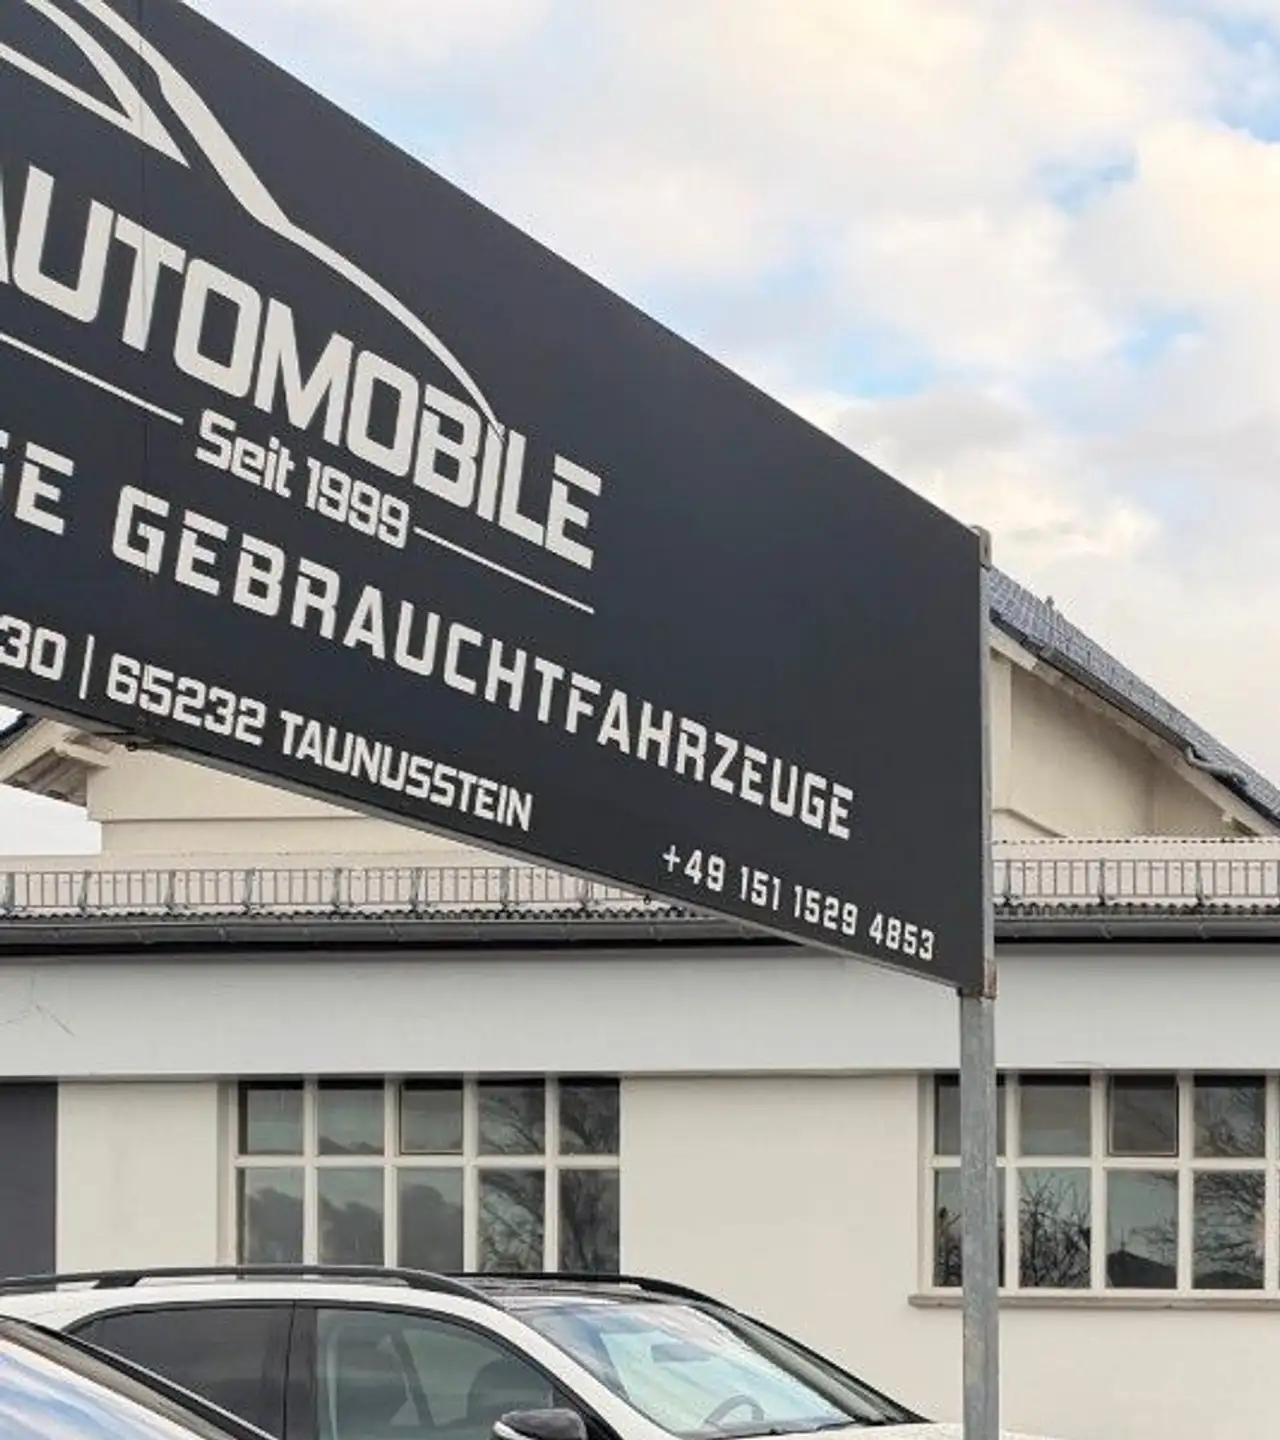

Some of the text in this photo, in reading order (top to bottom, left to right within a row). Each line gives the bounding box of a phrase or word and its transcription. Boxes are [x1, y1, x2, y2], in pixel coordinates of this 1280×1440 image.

[0, 165, 602, 570] UTOMOBILE
[194, 408, 411, 549] Seit 1999
[0, 430, 855, 840] E GEBRAUCHTFAHRZEUGE
[106, 653, 267, 746] 65232
[279, 710, 533, 832] TAUNUSSTEIN
[662, 844, 936, 961] +49 151 1529 4853
